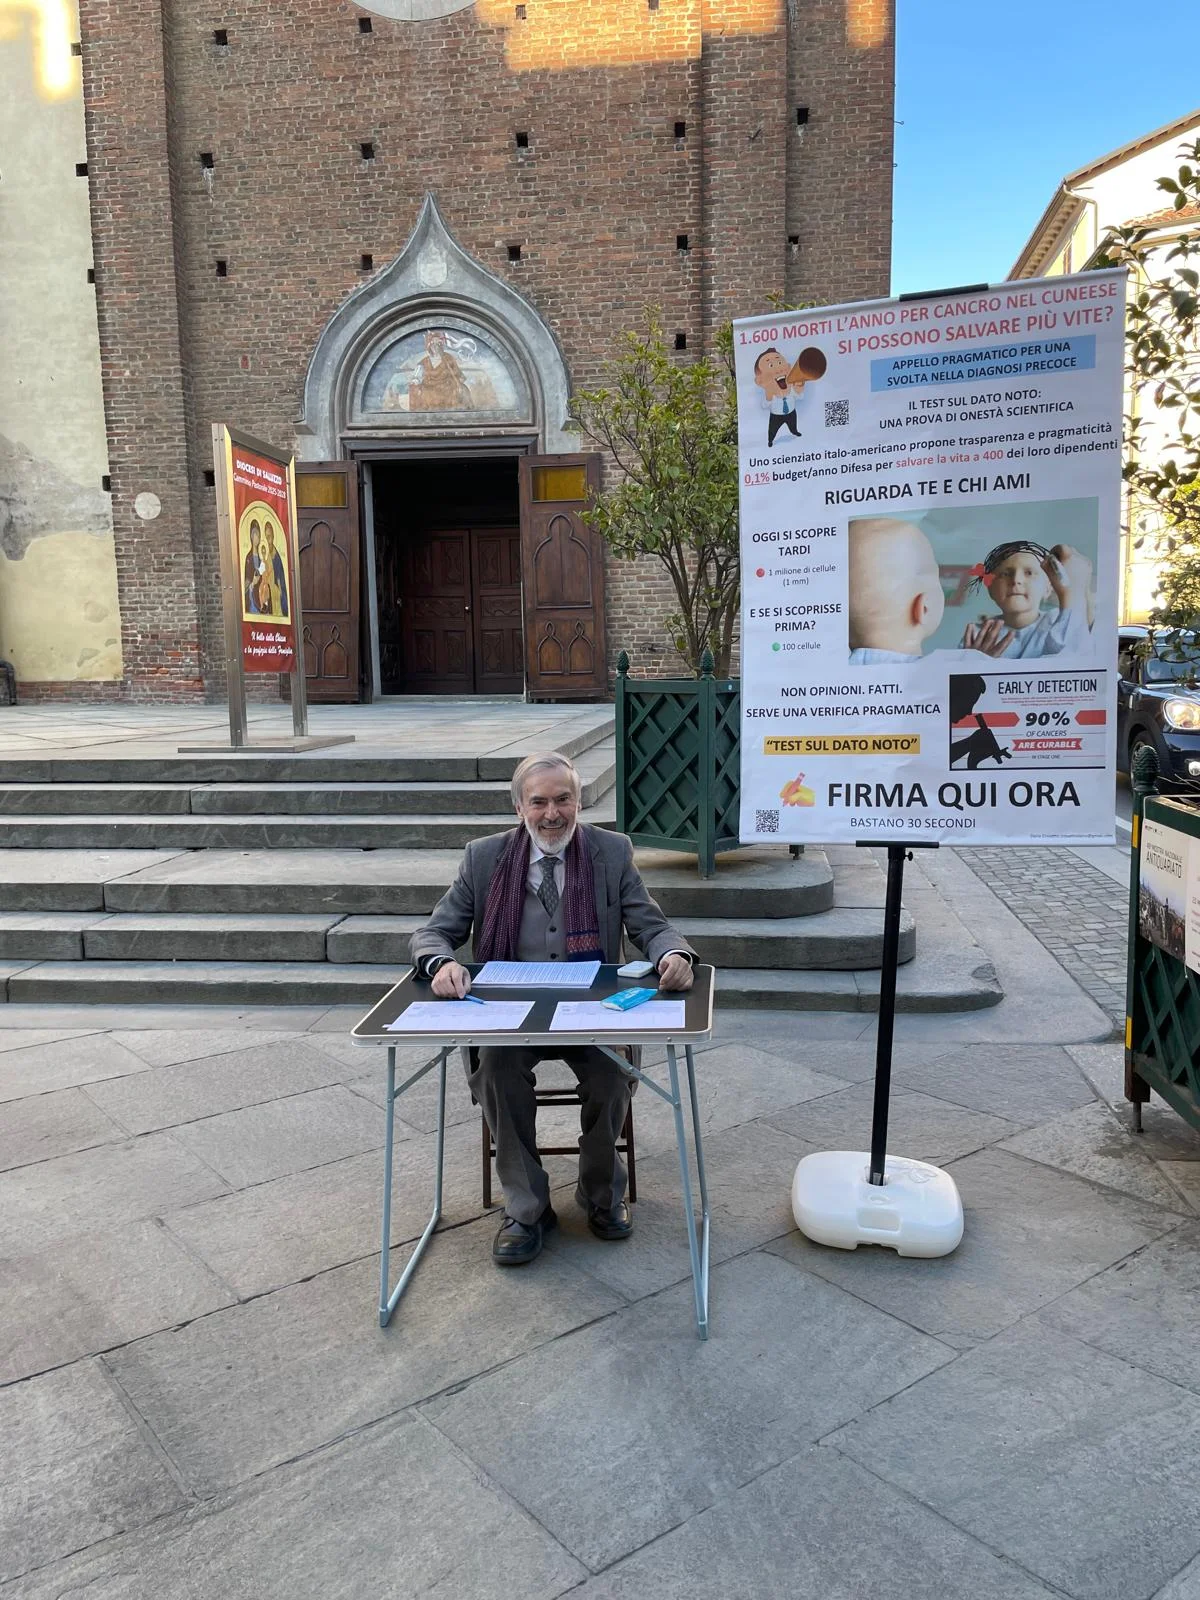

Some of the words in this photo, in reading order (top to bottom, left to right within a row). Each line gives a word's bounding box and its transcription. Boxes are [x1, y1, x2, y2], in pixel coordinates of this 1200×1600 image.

[740, 328, 778, 345] 1.600
[782, 320, 832, 339] MORTI
[837, 311, 895, 332] L’ANNO
[900, 307, 928, 323] PER
[934, 298, 1001, 319] CANCRO
[1006, 294, 1037, 309] NEL
[1041, 282, 1117, 304] CUNEESE
[838, 340, 852, 354] SI
[858, 329, 940, 352] POSSONO
[946, 317, 1021, 342] SALVARE
[1027, 307, 1056, 331] PIÙ
[1063, 306, 1114, 327] VITE?
[892, 356, 939, 370] APPELLO
[942, 347, 1017, 365] PRAGMATICO
[1021, 344, 1041, 357] PER
[1045, 342, 1071, 354] UNA
[887, 374, 928, 386] SVOLTA
[932, 369, 964, 381] NELLA
[967, 363, 1022, 378] DIAGNOSI
[1025, 357, 1077, 372] PRECOCE
[908, 401, 918, 410] IL
[919, 398, 945, 410] TEST
[947, 396, 968, 407] SUL
[971, 393, 1002, 404] DATO
[1005, 389, 1042, 401] NOTO:
[879, 420, 902, 430] UNA
[906, 412, 943, 426] PROVA
[946, 411, 957, 422] DI
[960, 406, 1004, 421] ONESTÀ
[1006, 401, 1074, 417] SCIENTIFICA
[749, 458, 770, 468] Uno
[772, 452, 822, 466] scienziato
[824, 442, 906, 459] italo-americano
[909, 438, 956, 452] propone
[959, 433, 1024, 448] trasparenza
[1028, 431, 1035, 440] e
[1038, 422, 1112, 441] pragmaticità
[236, 460, 255, 475] DIOCESI
[744, 472, 770, 486] 0,1%
[772, 466, 838, 482] budget/anno
[841, 463, 872, 474] Difesa
[875, 462, 893, 473] per
[896, 456, 933, 468] salvare
[937, 454, 947, 464] la
[950, 452, 970, 463] vita
[973, 453, 980, 462] a
[983, 450, 1004, 460] 400
[1006, 448, 1024, 459] dei
[1027, 447, 1050, 457] loro
[1053, 439, 1118, 455] dipendenti
[825, 483, 912, 505] RIGUARDA
[918, 480, 937, 496] TE
[944, 479, 952, 494] E
[958, 476, 987, 493] CHI
[993, 473, 1030, 491] AMI
[752, 532, 780, 542] OGGI
[783, 530, 792, 540] SI
[795, 526, 836, 539] SCOPRE
[779, 545, 810, 556] TARDI
[775, 567, 802, 576] milione
[812, 564, 836, 572] cellule
[782, 578, 790, 587] (1
[792, 577, 809, 586] mm)
[758, 608, 770, 617] SE
[773, 607, 782, 616] SI
[785, 604, 842, 616] SCOPRISSE
[775, 620, 816, 632] PRIMA?
[798, 642, 821, 650] cellule
[781, 687, 807, 697] NON
[810, 685, 865, 696] OPINIONI.
[868, 684, 902, 694] FATTI.
[998, 681, 1033, 694] EARLY
[1038, 679, 1097, 693] DETECTION
[746, 708, 780, 717] SERVE
[783, 708, 807, 717] UNA
[810, 706, 859, 717] VERIFICA
[863, 704, 941, 715] PRAGMATICA
[1026, 711, 1070, 727] 90%
[767, 740, 802, 751] “TEST
[805, 740, 829, 750] SUL
[832, 739, 868, 750] DATO
[872, 738, 917, 750] NOTO”
[1018, 741, 1034, 749] ARE
[1037, 740, 1076, 748] CURABLE
[828, 783, 928, 808] FIRMA
[937, 782, 996, 811] QUI
[1008, 781, 1080, 807] ORA
[851, 817, 904, 828] BASTANO
[908, 818, 922, 828] 30
[924, 818, 976, 828] SECONDI
[1146, 851, 1182, 878] ANTIQUARIATO
